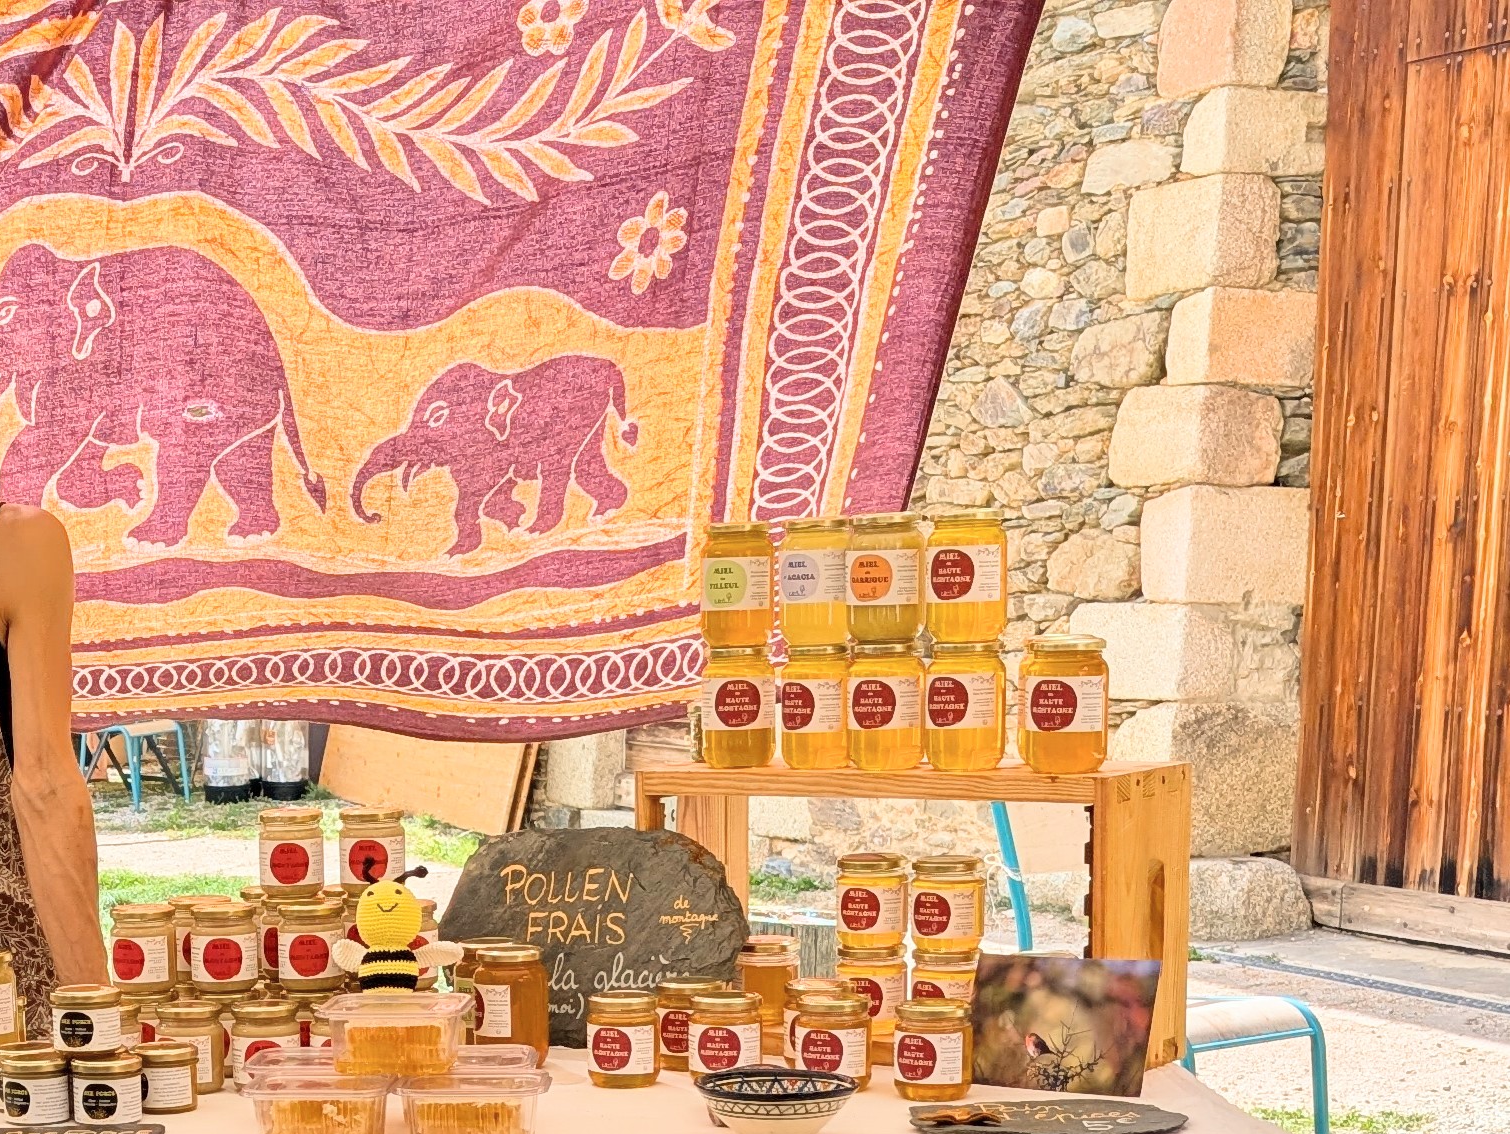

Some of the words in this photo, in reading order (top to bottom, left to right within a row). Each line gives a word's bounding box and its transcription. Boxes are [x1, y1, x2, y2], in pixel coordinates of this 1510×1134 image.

[500, 864, 634, 905] POLLEN
[674, 895, 690, 910] de
[659, 913, 719, 930] montagne
[549, 952, 579, 991] la
